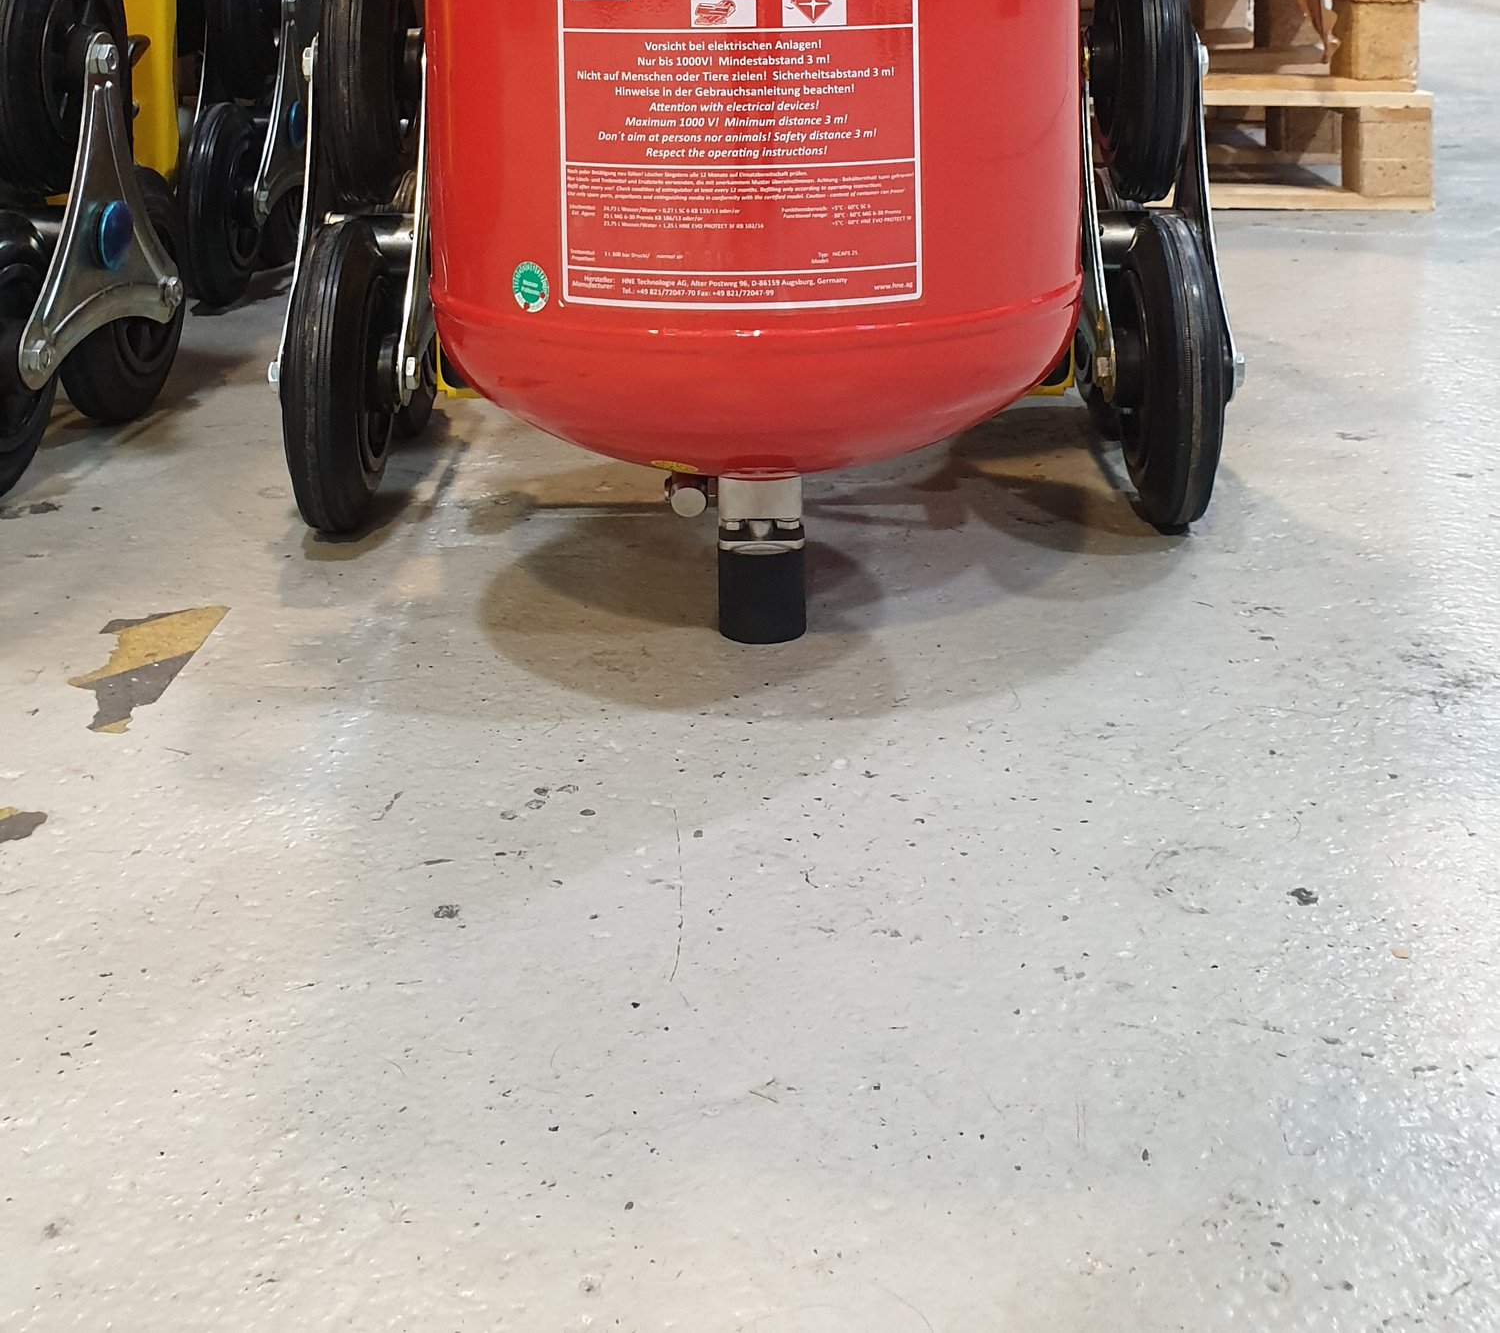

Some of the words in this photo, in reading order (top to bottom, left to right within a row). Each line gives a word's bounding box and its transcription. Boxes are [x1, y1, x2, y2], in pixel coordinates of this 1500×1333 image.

[644, 41, 686, 51] Vorsicht
[689, 41, 705, 51] bei
[707, 40, 772, 51] elektrischen
[775, 39, 821, 51] Anlagen!
[637, 57, 656, 66] Nur
[659, 56, 674, 66] bis
[676, 56, 712, 66] 1000V!
[718, 54, 804, 66] Mindestabstand
[807, 55, 813, 64] 3
[816, 54, 830, 64] m!
[577, 70, 601, 80] Nicht
[603, 70, 619, 81] auf
[621, 71, 673, 81] Menschen
[675, 71, 700, 81] oder
[702, 71, 729, 81] Tiere
[732, 70, 767, 81] zielen!
[772, 67, 870, 80] Sicherheitsabstand
[873, 67, 879, 77] 3
[881, 66, 894, 76] m!
[615, 86, 660, 97] Hinweise
[662, 86, 672, 96] in
[675, 87, 693, 97] der
[695, 86, 801, 97] Gebrauchsanleitung
[803, 83, 854, 95] beachten!
[649, 102, 697, 112] Attention
[700, 102, 724, 112] with
[726, 101, 775, 112] electrical
[777, 100, 819, 111] devices!
[625, 117, 676, 127] Maximum
[679, 117, 705, 127] 1000
[708, 117, 719, 127] V!
[724, 117, 776, 127] Minimum
[778, 116, 822, 126] distance
[824, 115, 831, 124] 3
[833, 114, 848, 124] m!
[627, 132, 646, 142] aim
[648, 133, 660, 142] at
[661, 134, 702, 144] persons
[725, 132, 771, 142] animals!
[773, 131, 807, 143] Safety
[809, 130, 852, 140] distance
[854, 129, 861, 138] 3
[863, 128, 877, 138] m!
[646, 147, 686, 159] Respect
[688, 147, 705, 157] the
[707, 147, 760, 159] operating
[762, 145, 828, 157] instructions!
[622, 277, 635, 285] HNE
[637, 278, 675, 288] Technologie
[677, 279, 689, 288] AG,
[690, 280, 707, 288] Alter
[709, 280, 738, 289] Postweg
[739, 280, 750, 288] 96,
[752, 279, 780, 287] D-86159
[781, 278, 815, 287] Augsburg,
[817, 277, 848, 286] Germany
